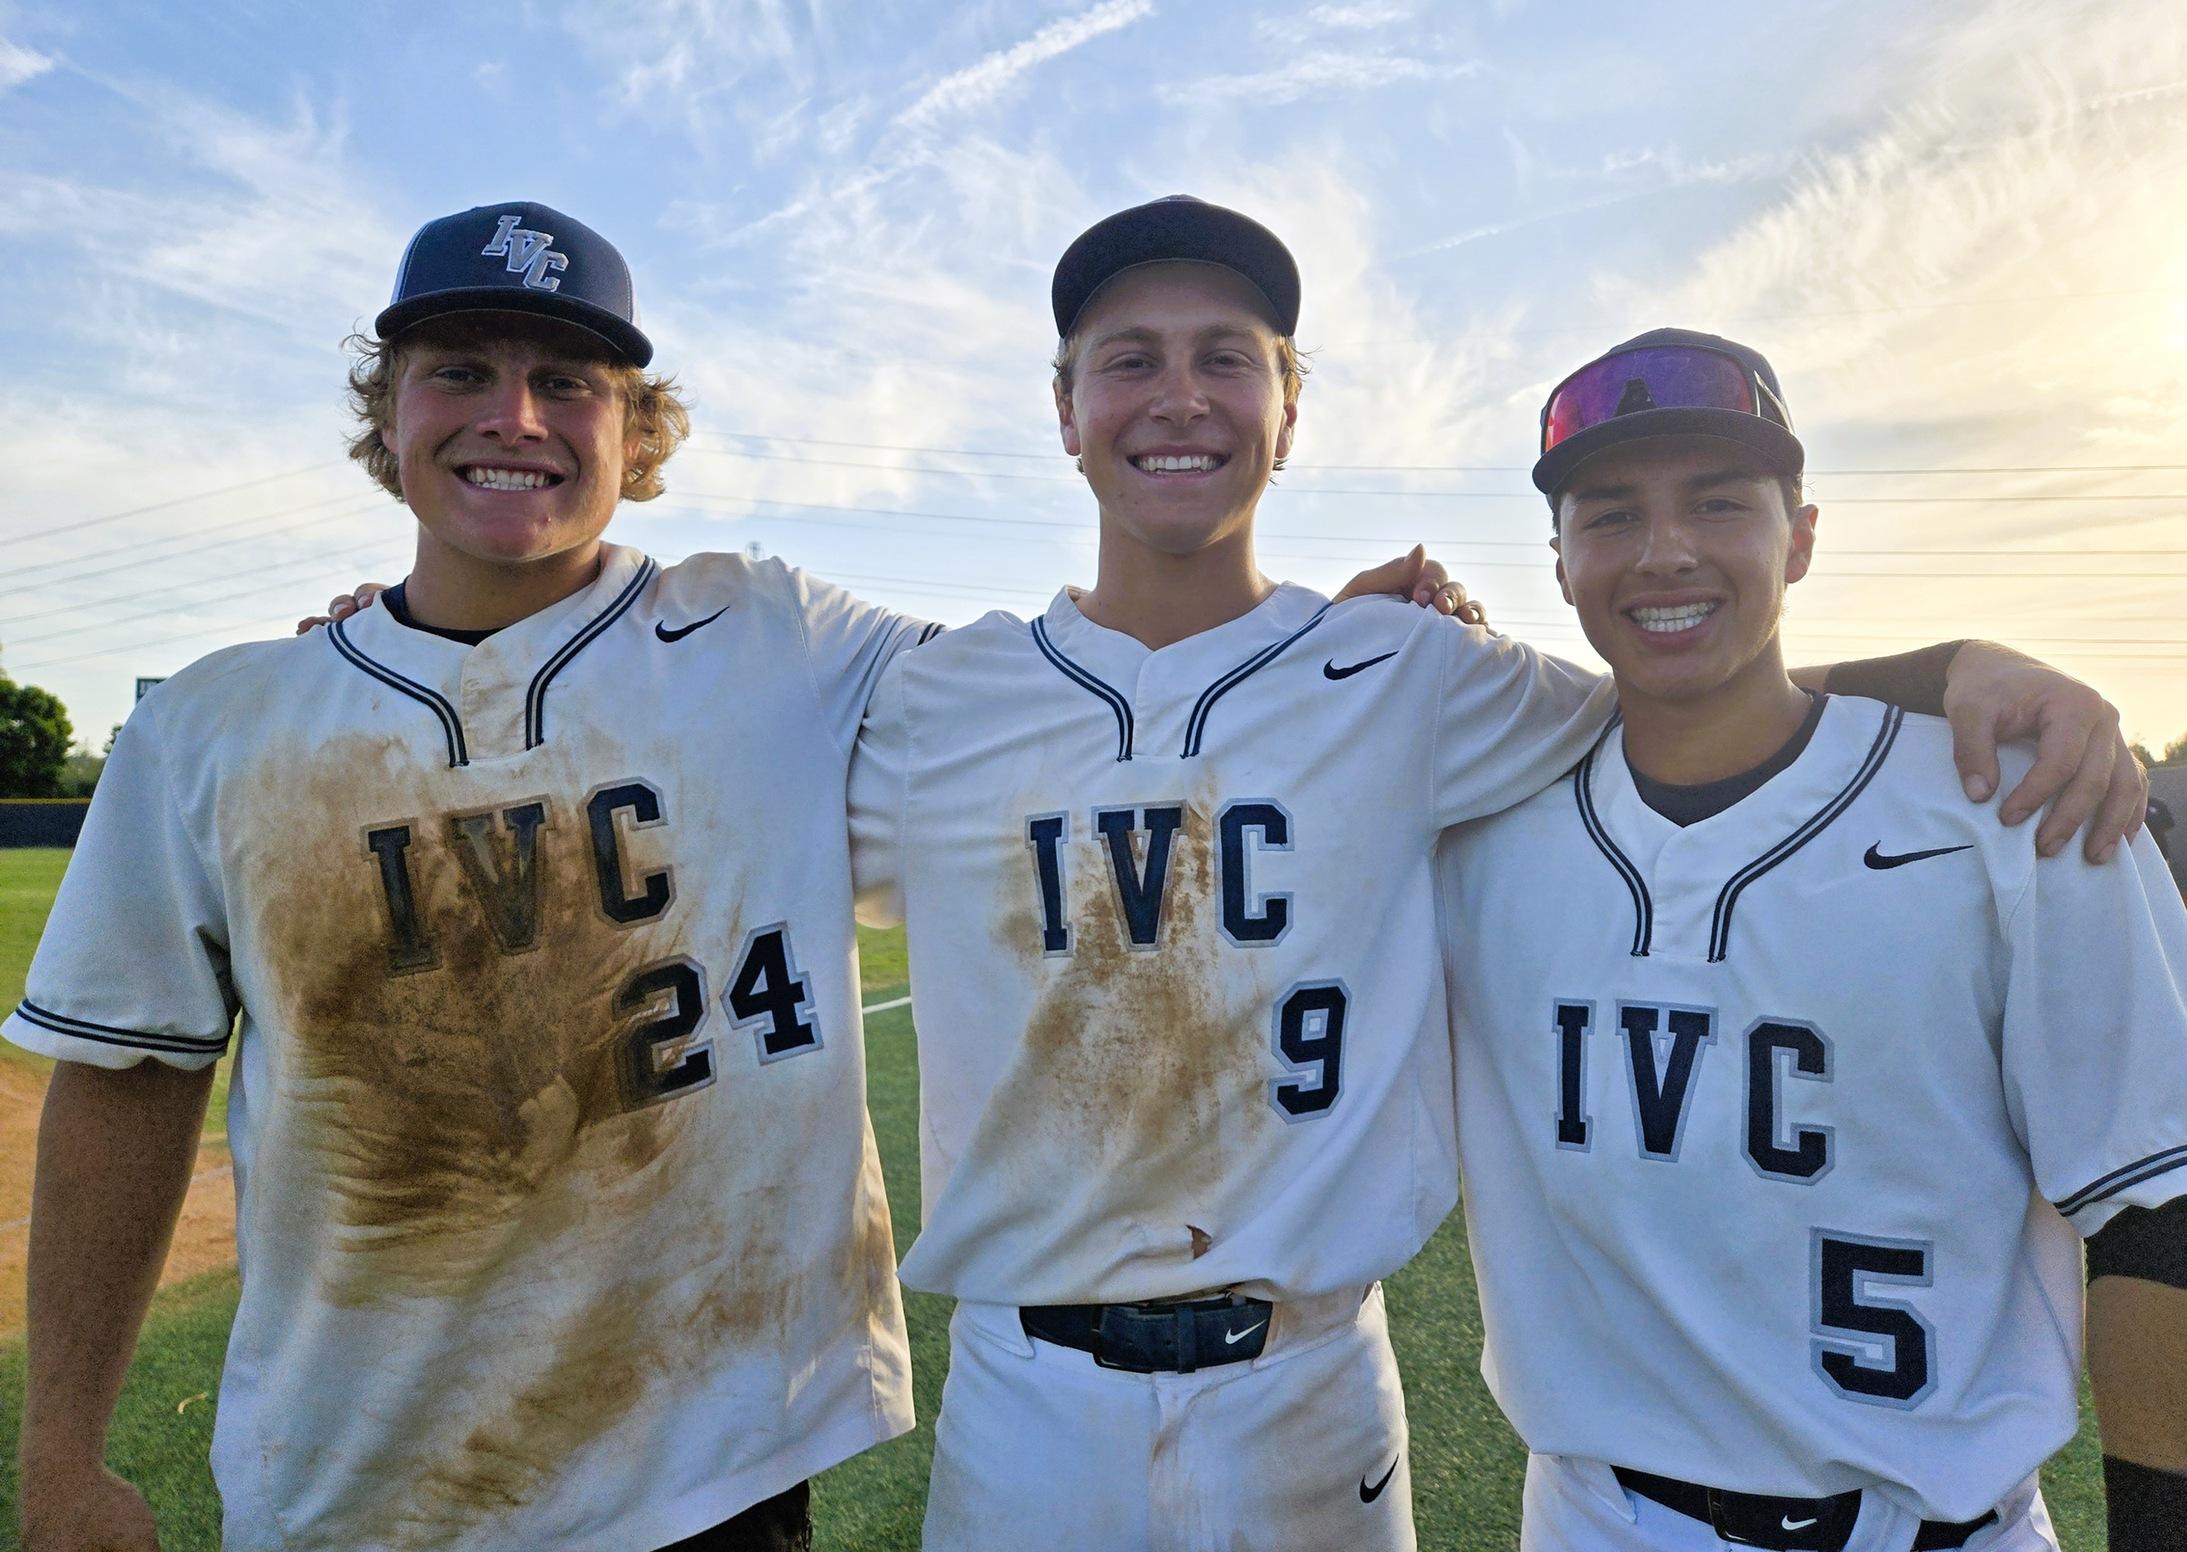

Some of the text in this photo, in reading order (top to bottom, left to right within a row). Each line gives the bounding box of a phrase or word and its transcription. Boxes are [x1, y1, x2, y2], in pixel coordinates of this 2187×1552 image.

[481, 214, 569, 292] IVC
[360, 776, 677, 978] IVC
[1025, 798, 1295, 959] IVC
[612, 921, 824, 1114] 24
[1268, 977, 1352, 1124] 9
[1552, 997, 1835, 1186] IVC
[1810, 1226, 1938, 1412] 5
